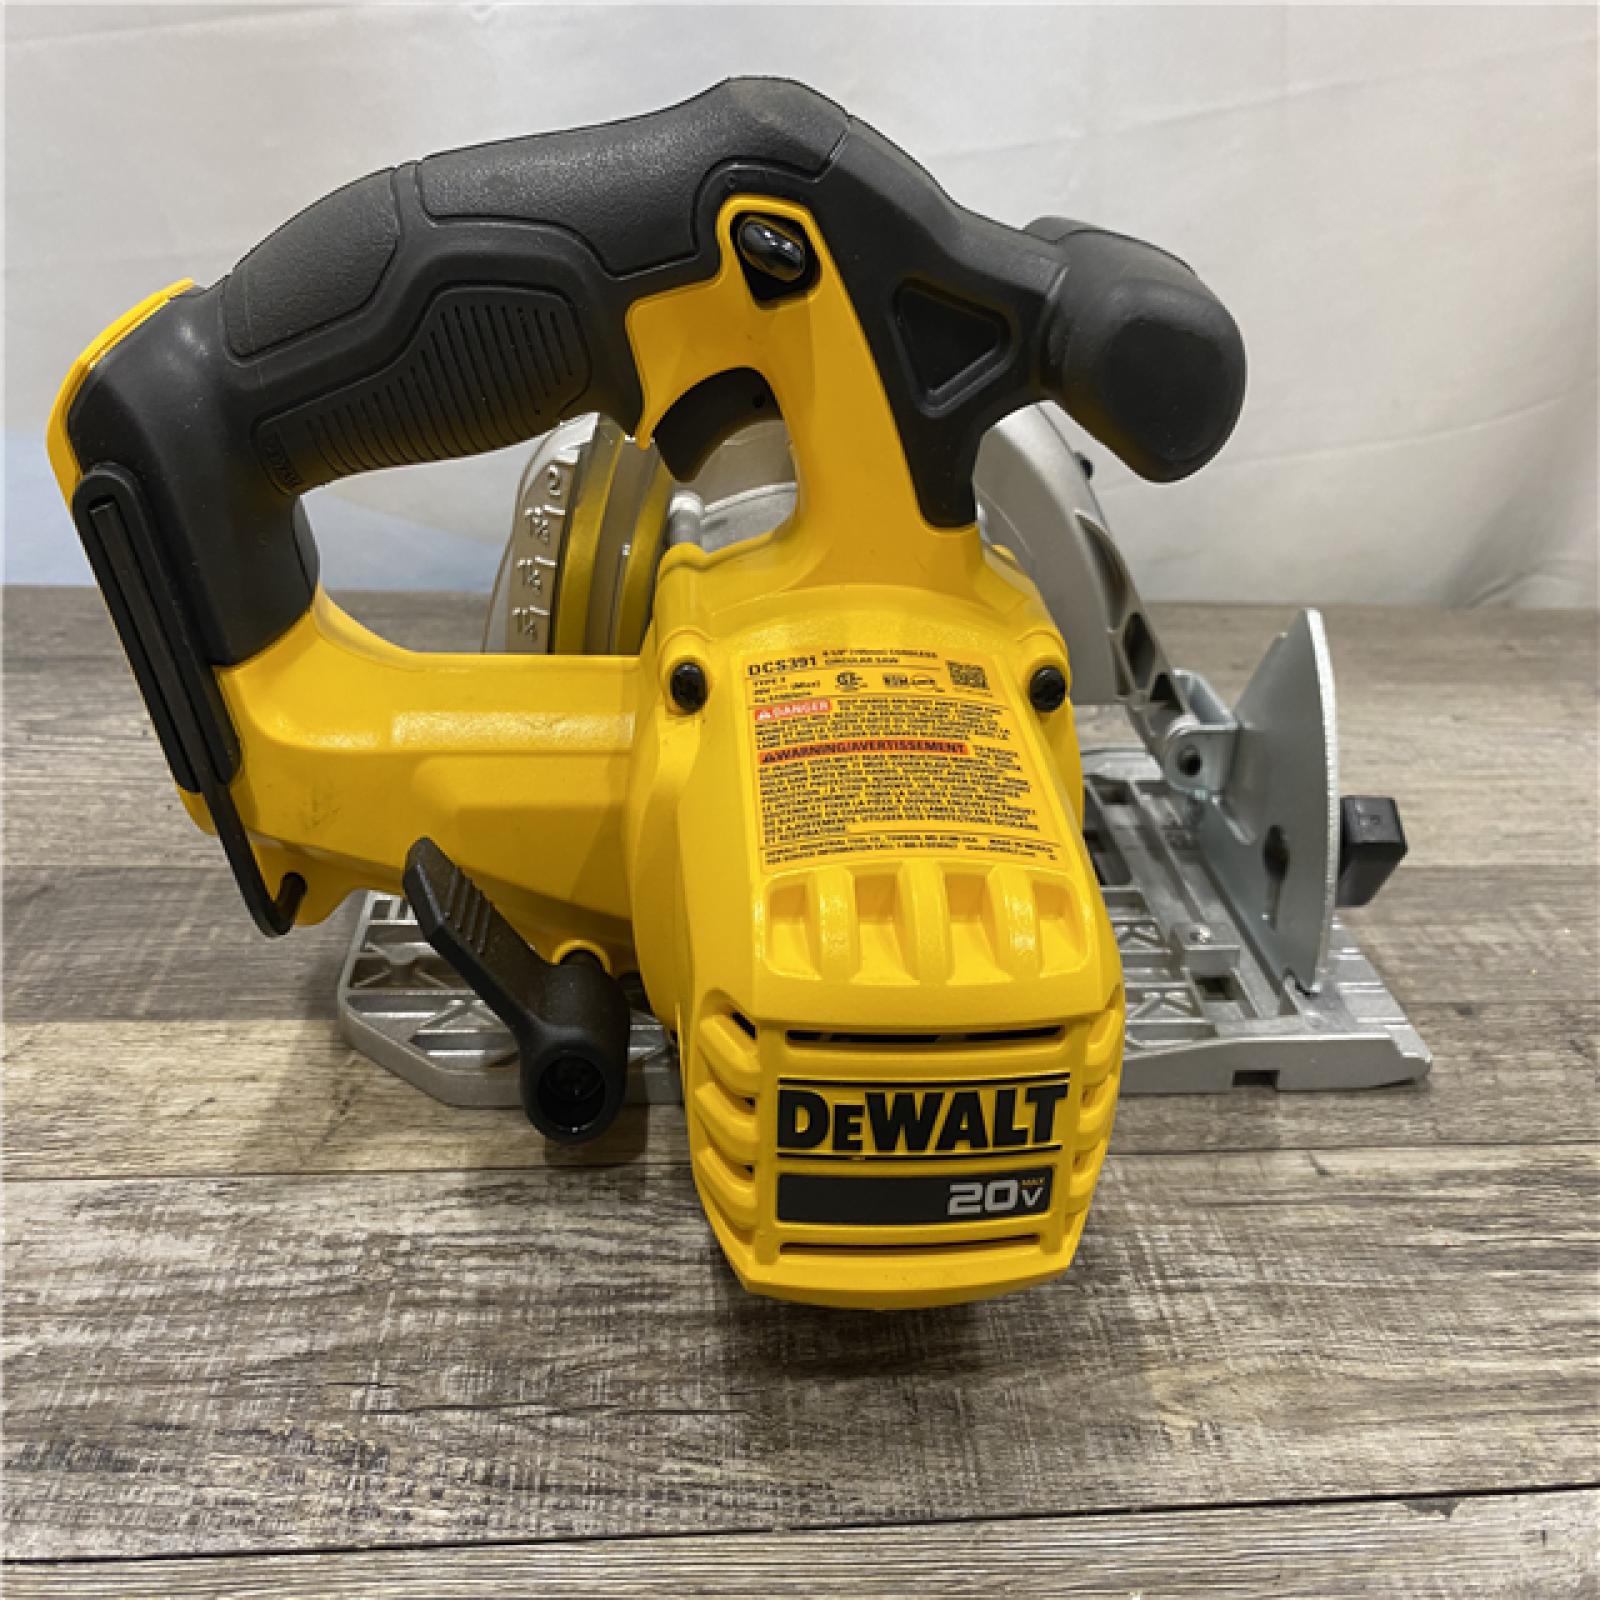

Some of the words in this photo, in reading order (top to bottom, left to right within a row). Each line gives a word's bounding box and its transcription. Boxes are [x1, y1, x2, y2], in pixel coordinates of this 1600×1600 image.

[747, 655, 817, 677] DCS391
[773, 700, 829, 718] DANGER
[772, 740, 966, 762] WARNING/AVERTISSEMENT
[777, 1082, 1068, 1153] DEWALT
